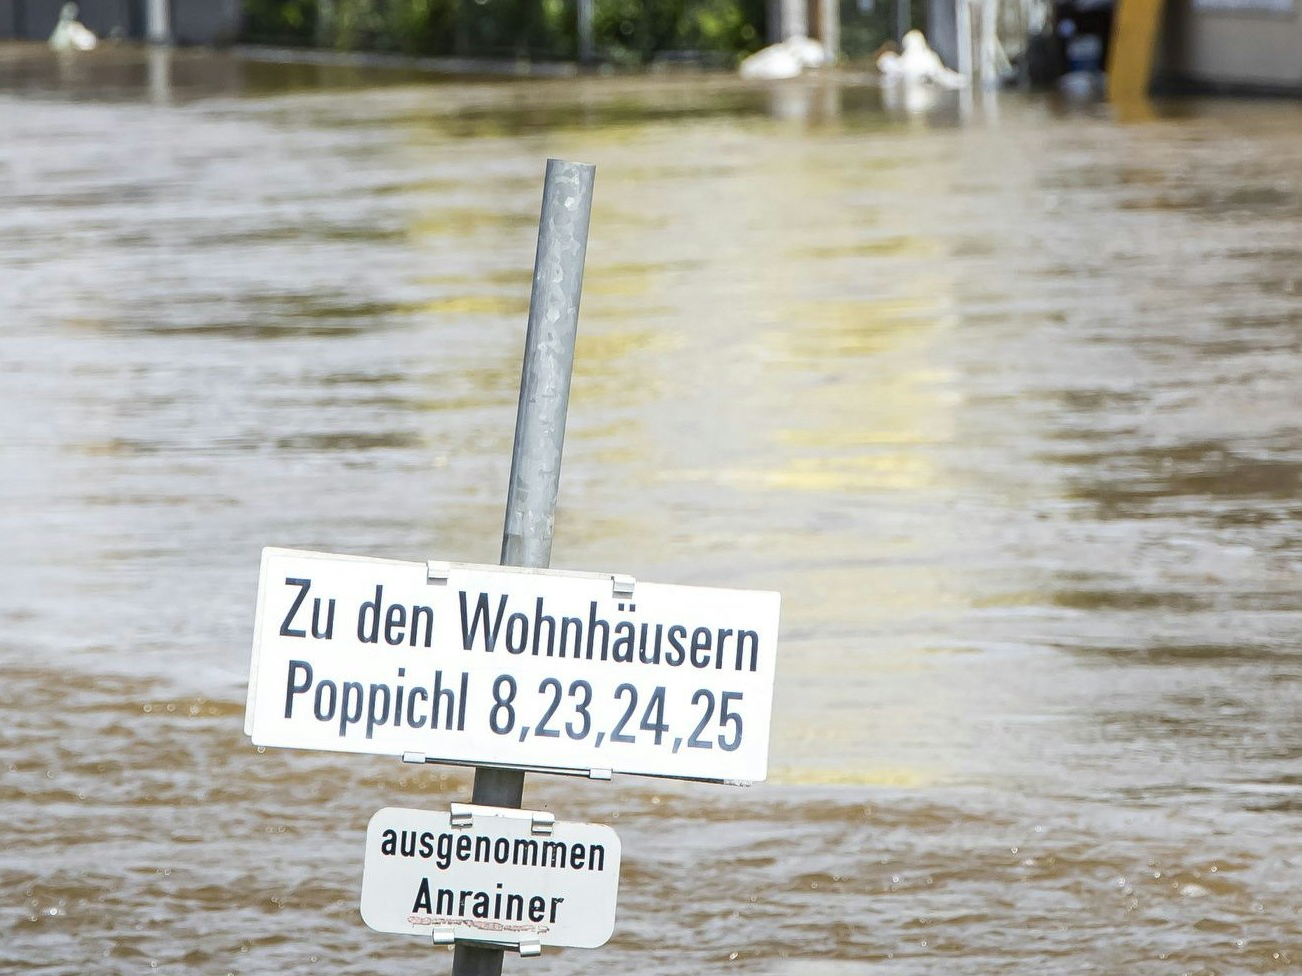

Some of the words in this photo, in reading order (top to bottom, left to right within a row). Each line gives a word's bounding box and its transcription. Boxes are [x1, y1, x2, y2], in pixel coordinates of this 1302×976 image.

[279, 578, 336, 640] Zu
[357, 585, 434, 648] den
[458, 591, 759, 672] Wohnhäusern
[284, 660, 469, 739] Poppichl
[489, 675, 744, 754] 8,23,24,25
[381, 828, 605, 872] ausgenommen
[412, 877, 565, 924] Anrainer
